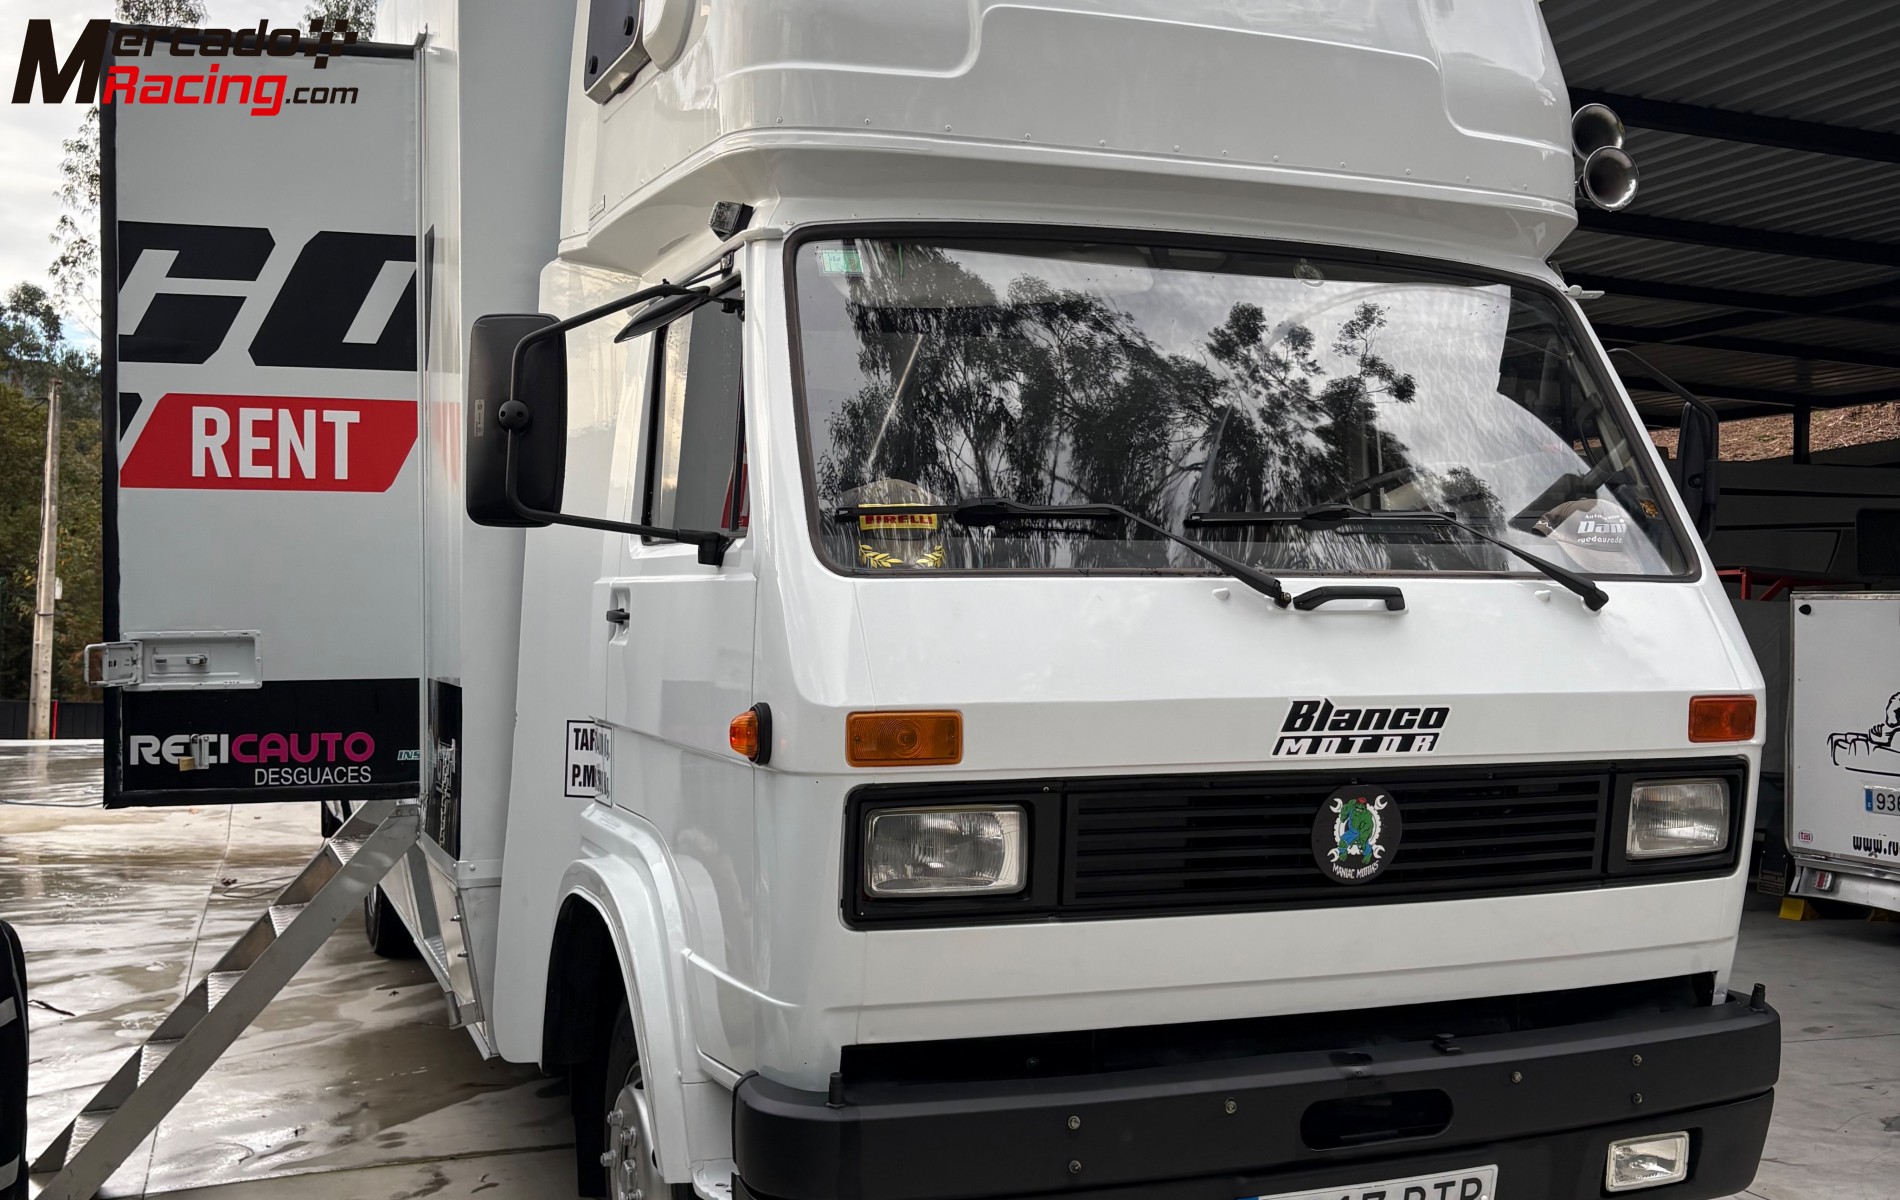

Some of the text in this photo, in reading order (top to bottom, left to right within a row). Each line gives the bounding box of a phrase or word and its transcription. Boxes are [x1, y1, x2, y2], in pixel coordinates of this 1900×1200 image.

[191, 406, 361, 480] RENT
[1578, 519, 1626, 534] Dani
[1280, 697, 1451, 733] Blanco
[1277, 734, 1436, 757] MOTOR
[254, 766, 372, 786] DESGUACES
[1332, 862, 1355, 879] MANIAC
